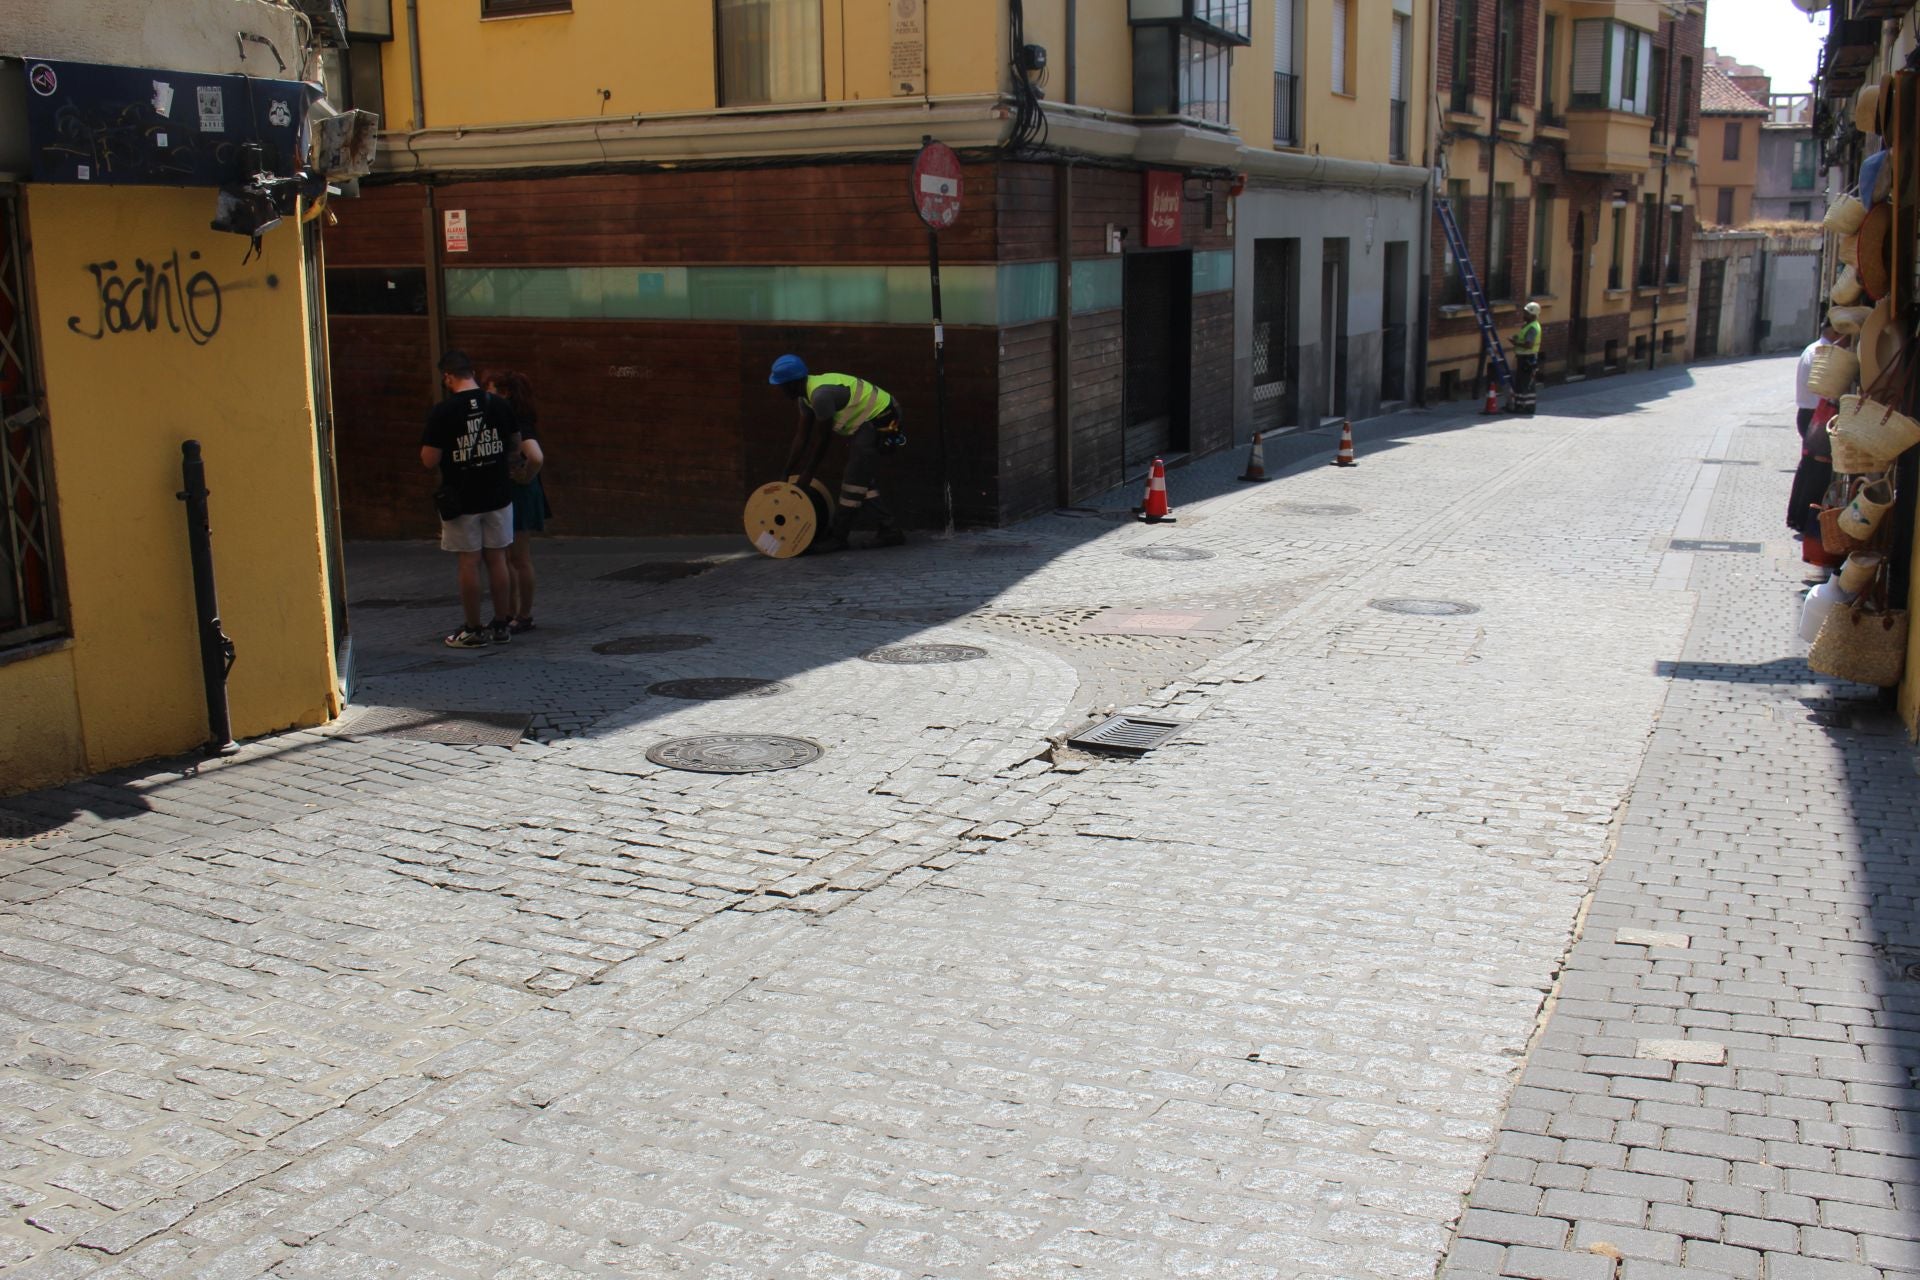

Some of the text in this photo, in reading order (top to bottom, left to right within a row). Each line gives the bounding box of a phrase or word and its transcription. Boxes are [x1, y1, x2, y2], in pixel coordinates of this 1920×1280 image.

[466, 416, 487, 433] NO
[492, 428, 499, 441] A
[452, 440, 504, 462] ENTNDER
